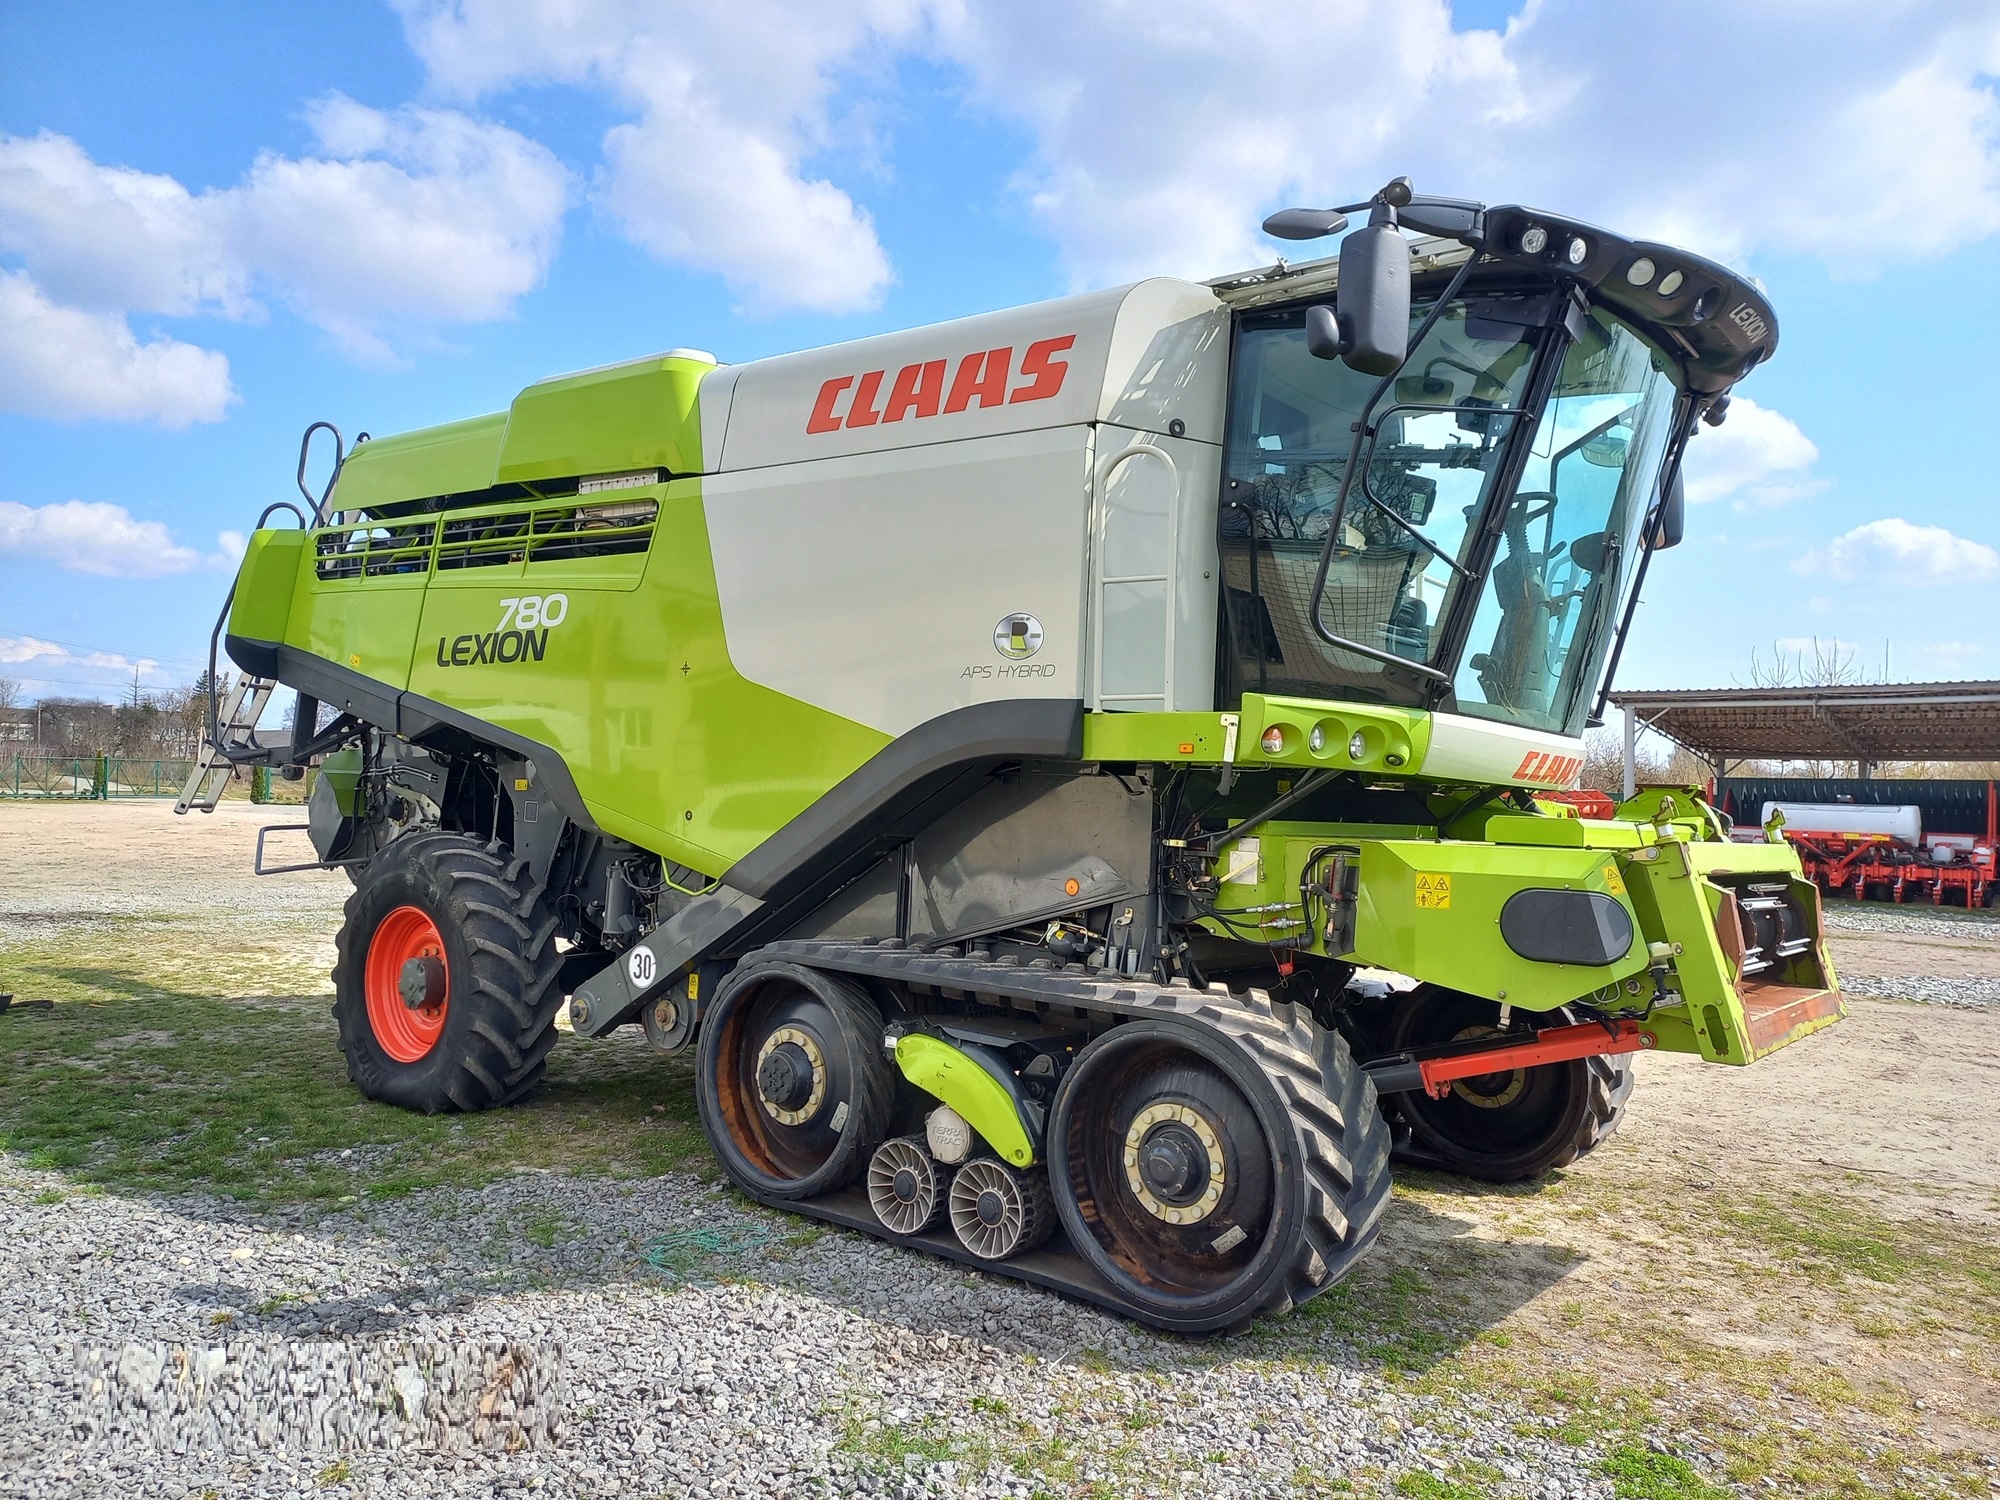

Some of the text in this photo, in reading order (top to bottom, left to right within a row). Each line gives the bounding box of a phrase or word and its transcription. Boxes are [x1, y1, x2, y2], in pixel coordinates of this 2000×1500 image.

[1729, 302, 1769, 344] LEXION
[806, 334, 1077, 435] CLAAS
[495, 593, 569, 632] 780
[437, 628, 549, 668] LEXION
[960, 664, 1056, 679] APS HYBRID
[1512, 751, 1584, 786] CLAAS
[633, 953, 652, 980] 30
[933, 1126, 963, 1137] TERRA
[936, 1135, 961, 1146] TRAC
